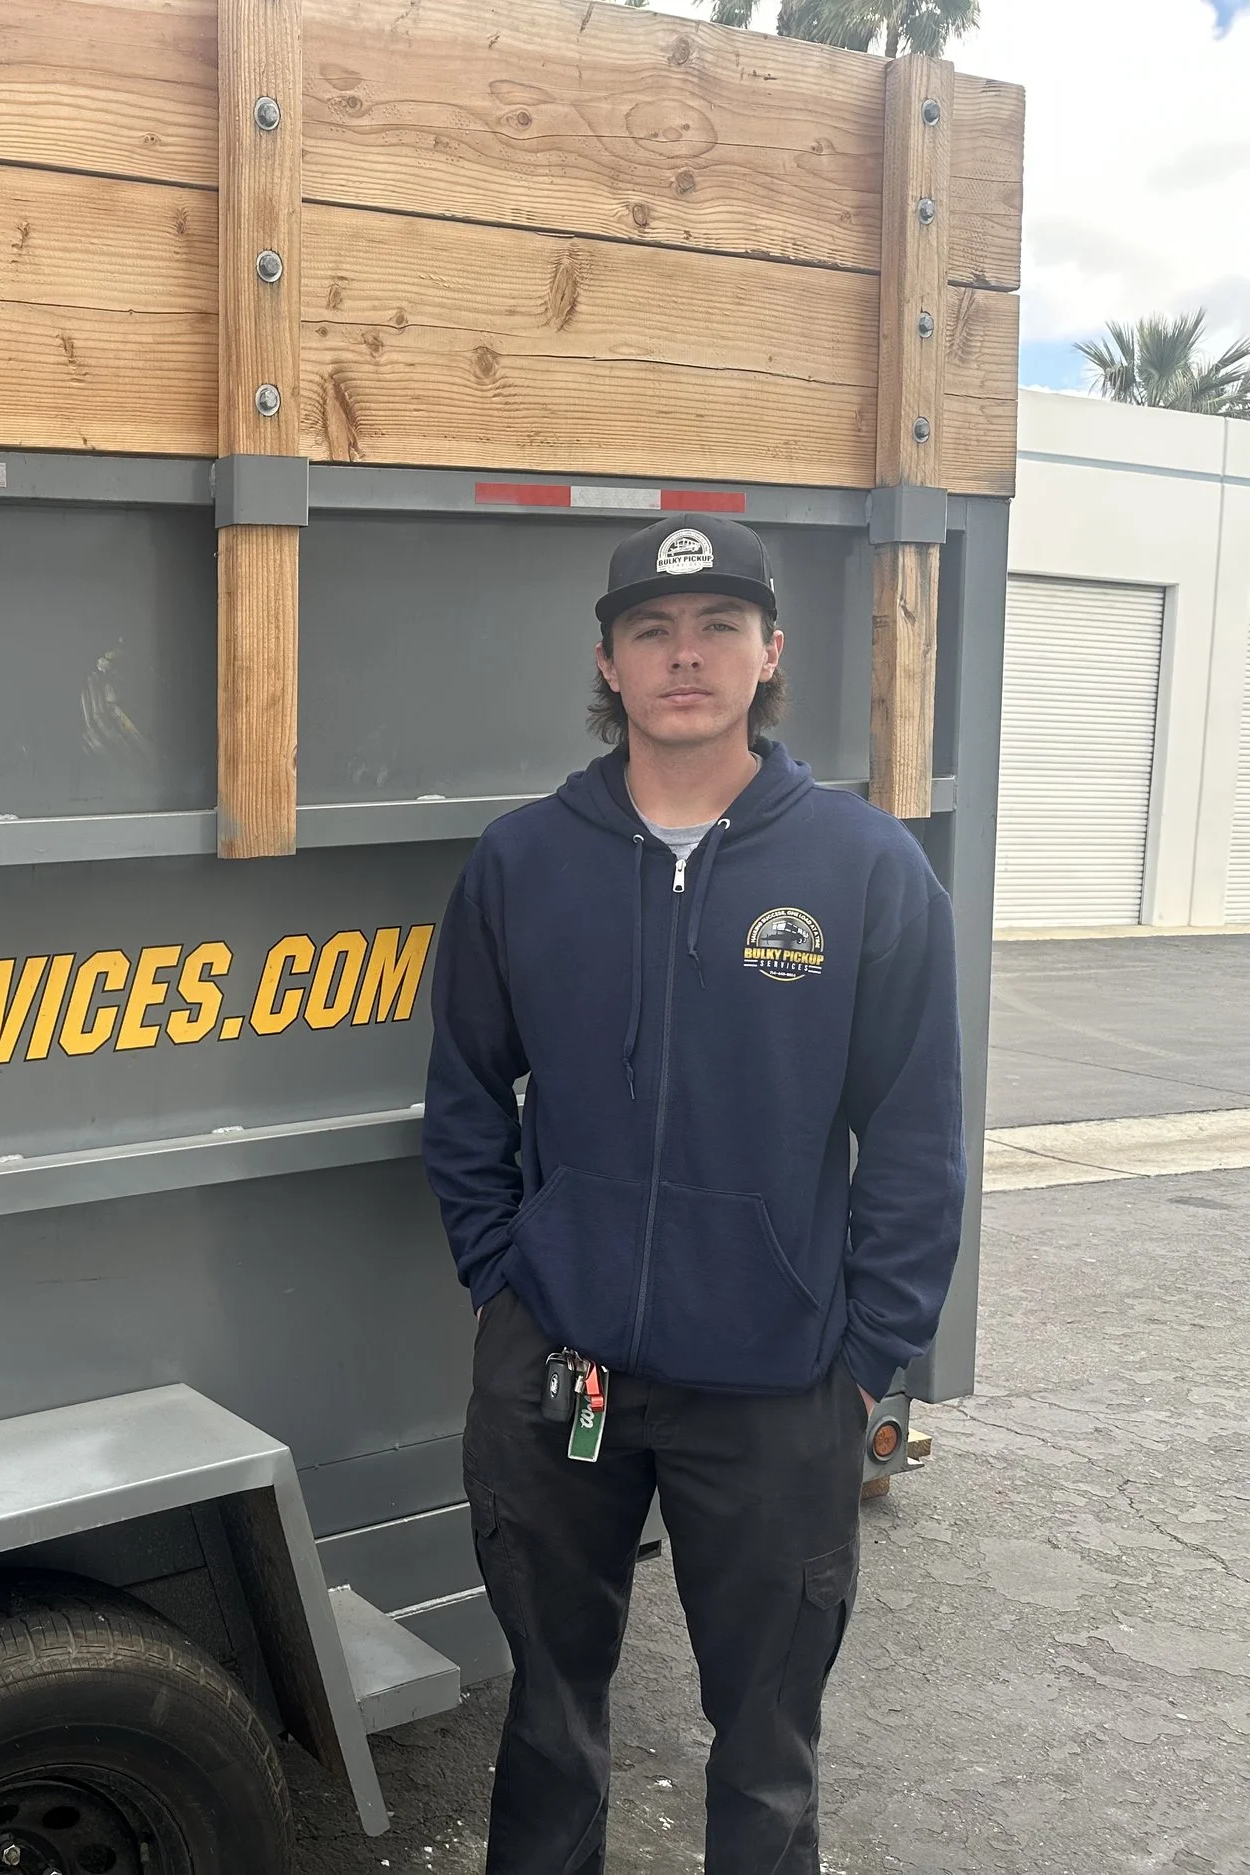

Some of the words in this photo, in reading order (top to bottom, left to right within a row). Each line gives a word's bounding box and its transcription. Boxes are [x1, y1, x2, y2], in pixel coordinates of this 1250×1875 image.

[659, 557, 682, 566] BULKY
[799, 914, 811, 925] LOAD
[744, 947, 782, 960] BULKY
[783, 950, 824, 965] PICKUP
[760, 960, 808, 971] SERVICES
